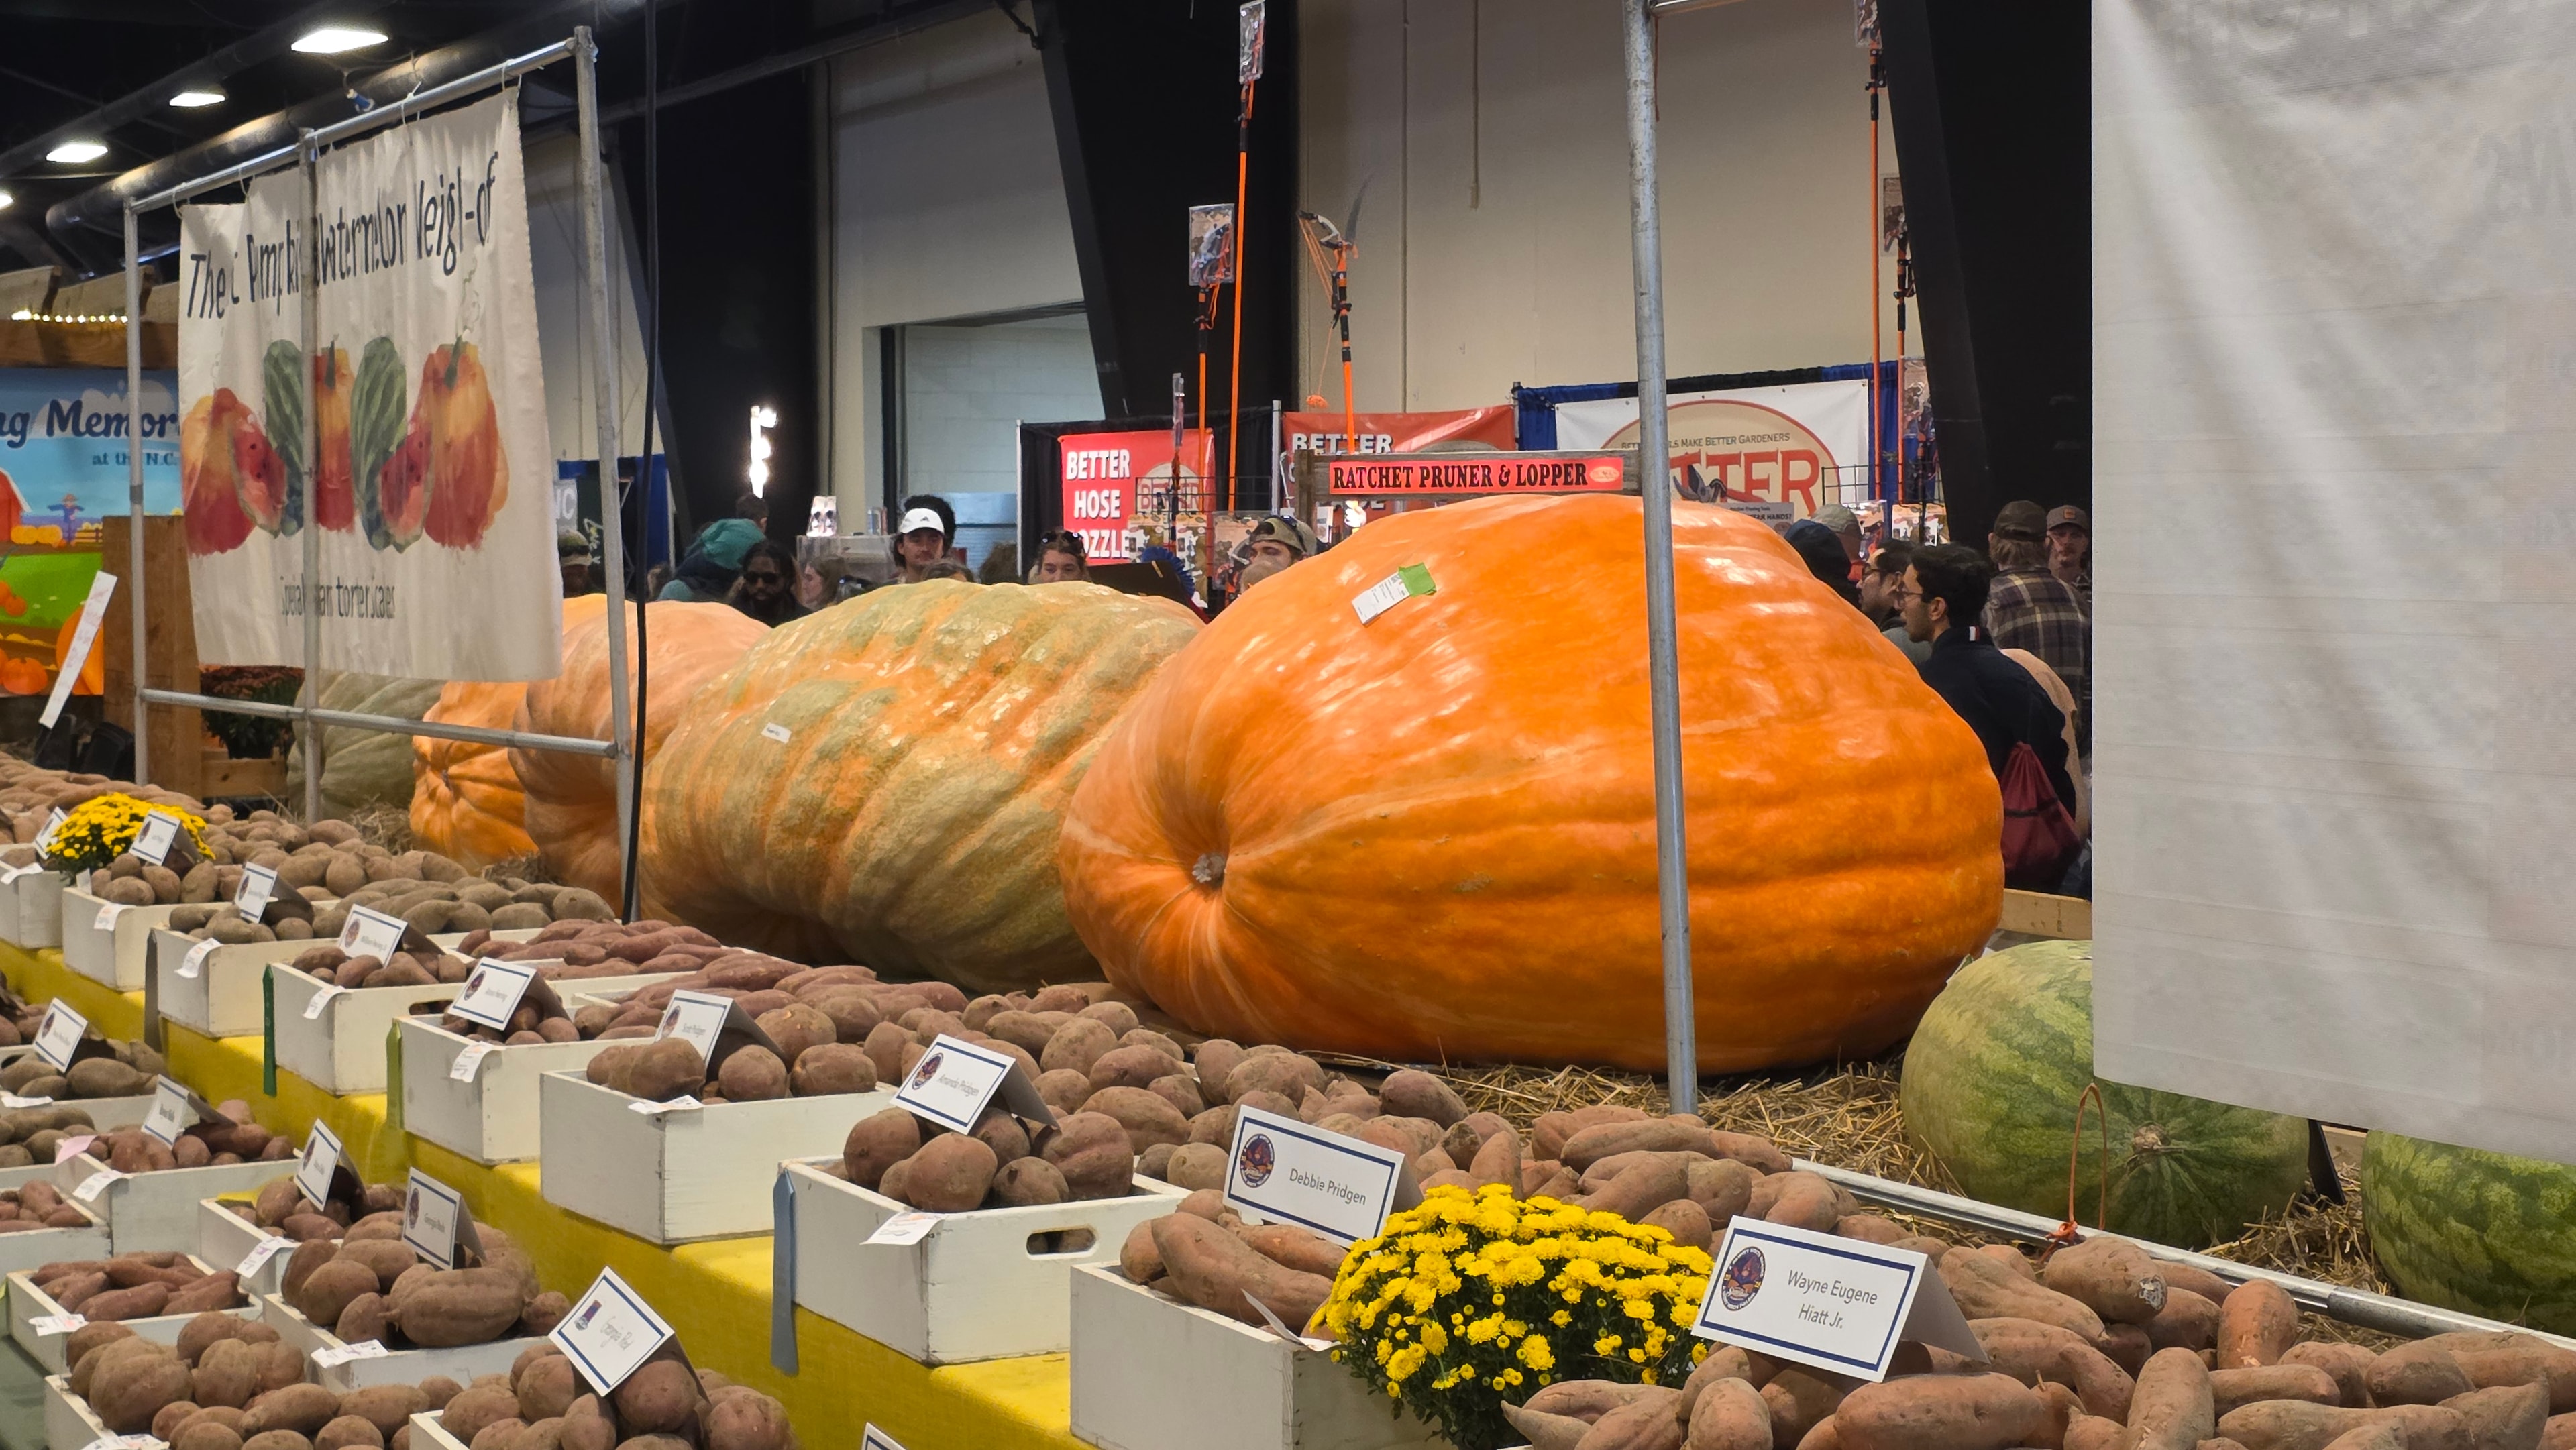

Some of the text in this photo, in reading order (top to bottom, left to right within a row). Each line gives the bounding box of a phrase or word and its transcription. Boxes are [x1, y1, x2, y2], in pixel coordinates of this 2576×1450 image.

[187, 251, 226, 319] The
[46, 399, 180, 437] Memor
[1681, 438, 1703, 448] MAKE
[1705, 436, 1737, 446] BETTER
[1738, 432, 1790, 444] GARDENERS
[93, 453, 109, 465] at
[115, 452, 132, 465] th
[1066, 449, 1130, 480] BETTER
[1333, 467, 1413, 489] RATCHET
[1419, 464, 1492, 488] PRUNER
[1498, 465, 1510, 487] &
[1515, 463, 1588, 487] LOPPER
[1074, 490, 1121, 519] HOSE
[1289, 1168, 1366, 1206] Debbie Pridgen
[1786, 1269, 1829, 1296] Wayne
[1830, 1280, 1878, 1305] Eugene
[1798, 1303, 1843, 1329] Hiatt Jr.
